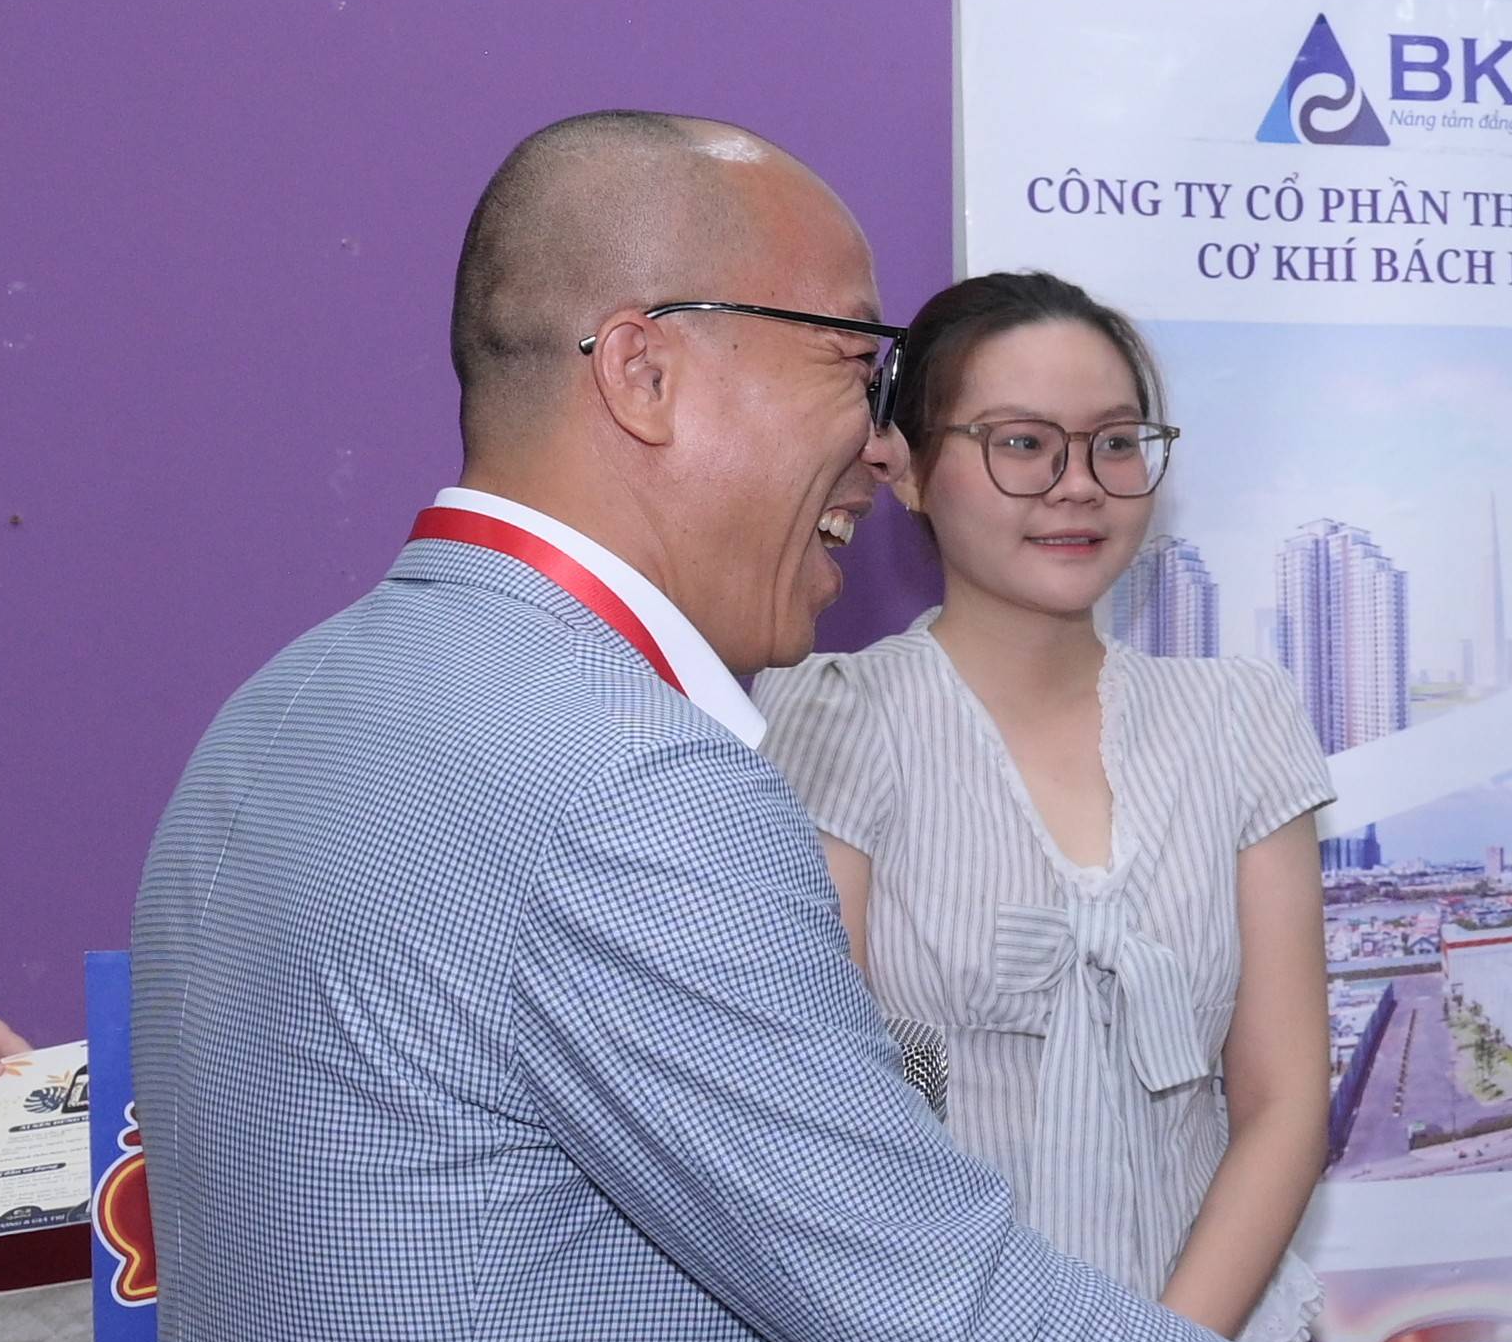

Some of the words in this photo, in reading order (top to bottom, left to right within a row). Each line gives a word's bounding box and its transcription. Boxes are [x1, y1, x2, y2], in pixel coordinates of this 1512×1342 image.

[1389, 109, 1437, 132] Nâng
[1441, 106, 1474, 130] tầm
[1027, 167, 1163, 217] CÔNG
[1175, 180, 1233, 220] TY
[1245, 171, 1305, 223] CỔ
[1319, 176, 1452, 226] PHẦN
[1197, 241, 1261, 281] CƠ
[1272, 236, 1358, 283] KHÍ
[1372, 237, 1496, 286] BÁCH
